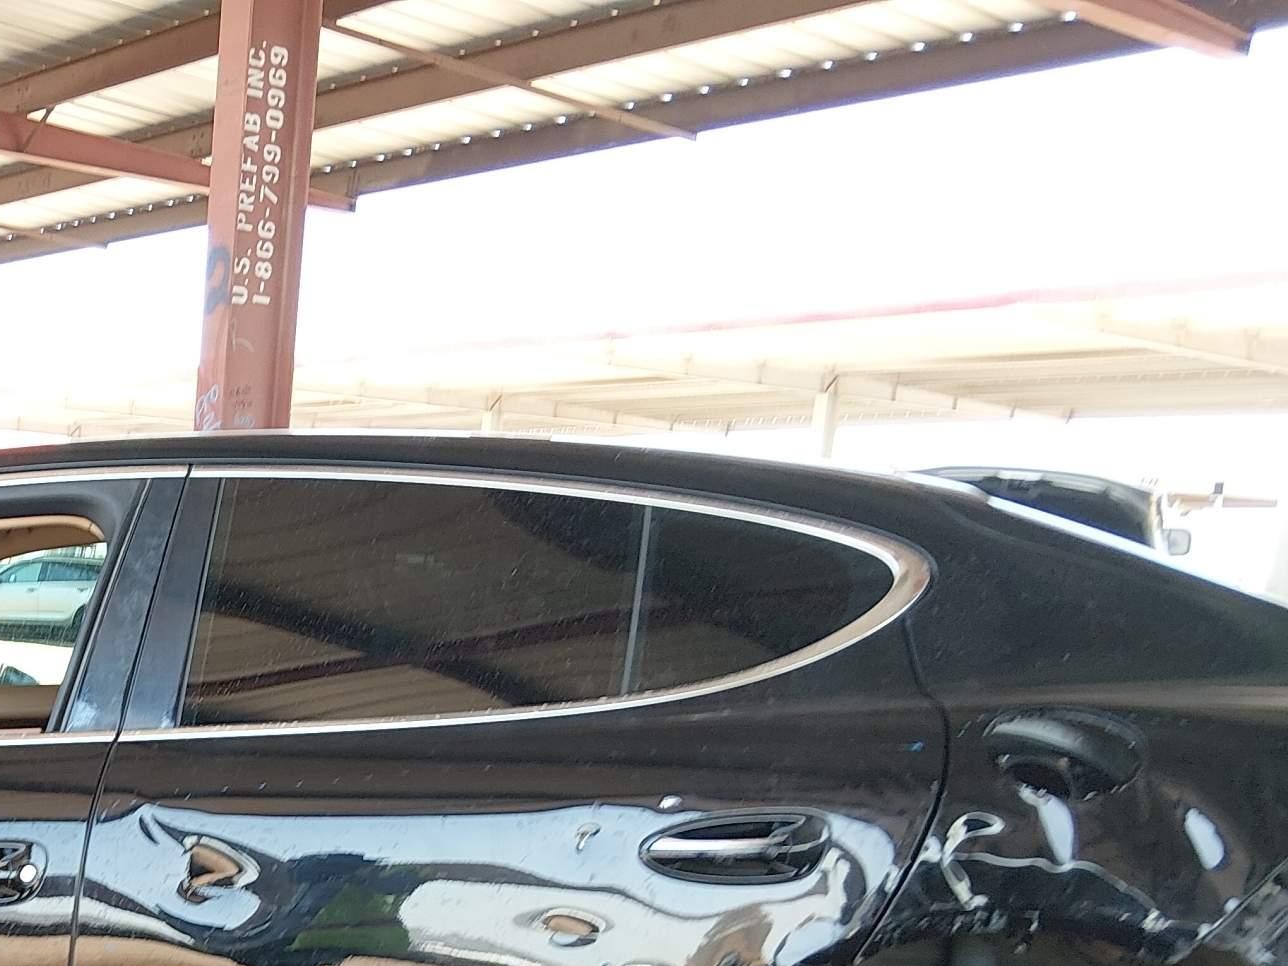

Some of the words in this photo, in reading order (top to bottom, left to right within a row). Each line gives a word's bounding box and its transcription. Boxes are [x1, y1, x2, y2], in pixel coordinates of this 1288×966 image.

[247, 40, 268, 99] INC.
[236, 111, 261, 233] PREFAB
[252, 45, 289, 306] 1-866-799-0969
[231, 247, 252, 305] U.S.
